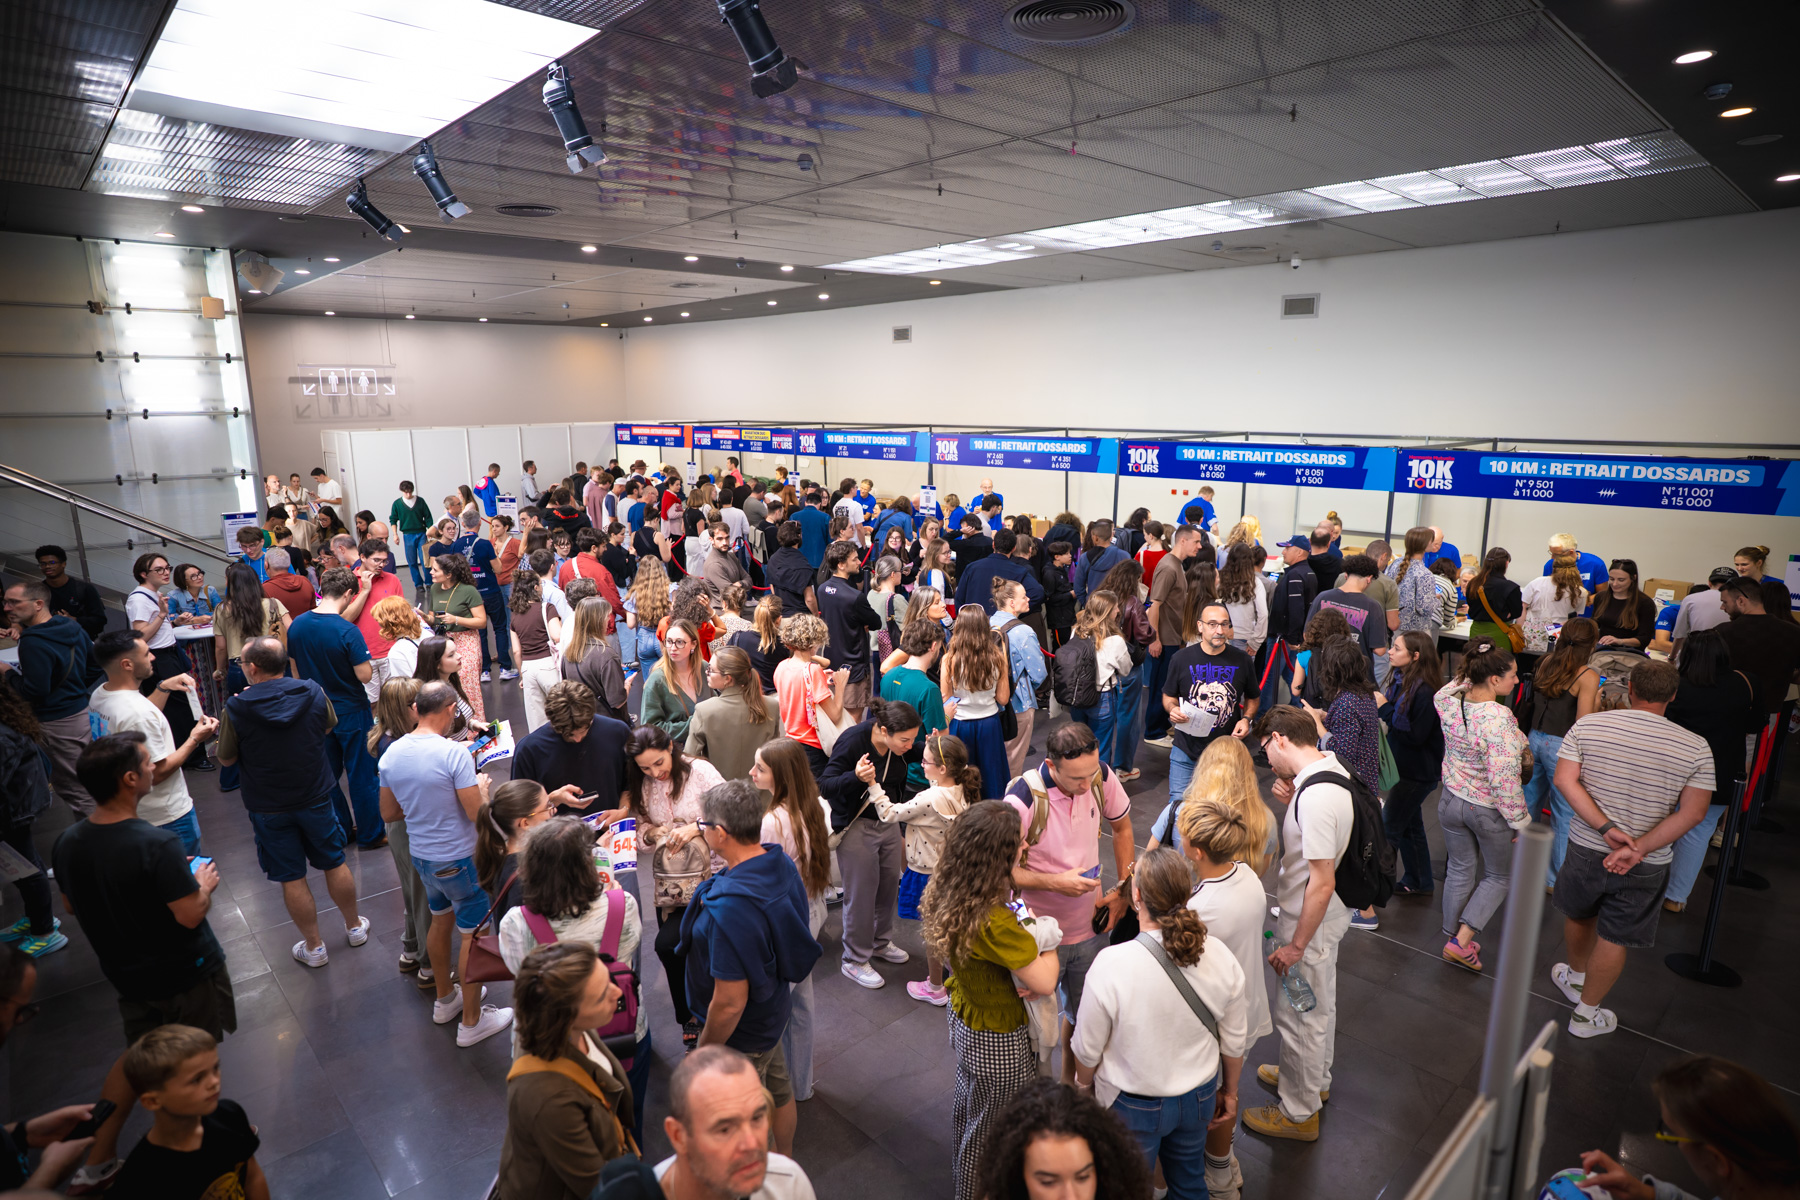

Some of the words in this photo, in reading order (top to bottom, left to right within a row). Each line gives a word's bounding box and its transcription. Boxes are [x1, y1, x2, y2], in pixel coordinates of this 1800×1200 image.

[799, 435, 816, 446] 10K
[847, 435, 872, 444] RETRAIT
[872, 436, 907, 445] DOSSARDS
[936, 440, 958, 454] 10K
[974, 440, 983, 449] 10
[984, 441, 996, 450] KM
[1001, 441, 1036, 451] RETRAIT
[1037, 442, 1086, 453] DOSSARDS
[936, 453, 958, 461] TOURS
[1128, 448, 1159, 464] 10K
[1182, 449, 1195, 459] 10
[1197, 449, 1215, 460] KM
[1222, 450, 1273, 462] RETRAIT
[1275, 452, 1346, 465] DOSSARDS
[1128, 463, 1159, 473] TOURS
[1408, 459, 1454, 479] 10K
[1490, 461, 1508, 473] 10
[1511, 461, 1539, 474] KM
[1541, 464, 1546, 475] :
[1550, 463, 1630, 478] RETRAIT
[1632, 466, 1750, 483] DOSSARDS
[1407, 477, 1452, 490] TOURS
[1515, 479, 1526, 487] N°
[1536, 480, 1553, 489] 501
[1513, 488, 1519, 496] à
[1533, 489, 1554, 498] 000
[1662, 486, 1676, 495] N°
[1678, 487, 1688, 496] 11
[1691, 488, 1714, 497] 001
[1661, 496, 1668, 505] à
[1671, 497, 1683, 506] 15
[1686, 498, 1712, 507] 000
[1189, 662, 1239, 685] HELLFEST
